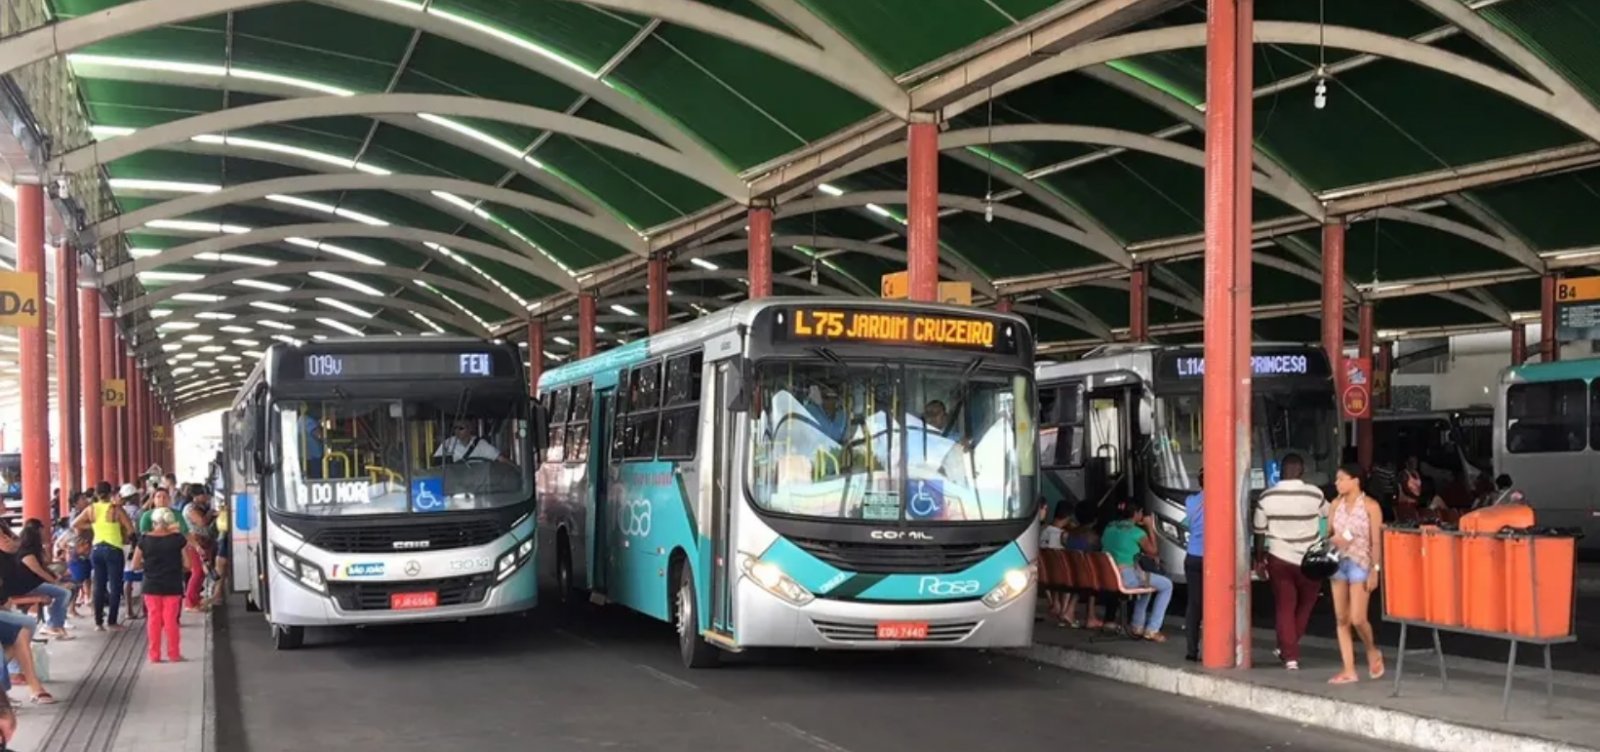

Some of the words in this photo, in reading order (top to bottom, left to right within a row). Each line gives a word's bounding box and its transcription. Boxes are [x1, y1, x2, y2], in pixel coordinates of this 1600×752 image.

[1559, 284, 1577, 299] B4
[0, 291, 37, 316] D4
[795, 310, 845, 336] L75
[846, 314, 909, 340] JARDIM
[913, 318, 994, 345] CRUZEIRO
[312, 483, 332, 504] DO
[918, 575, 980, 594] Rosa
